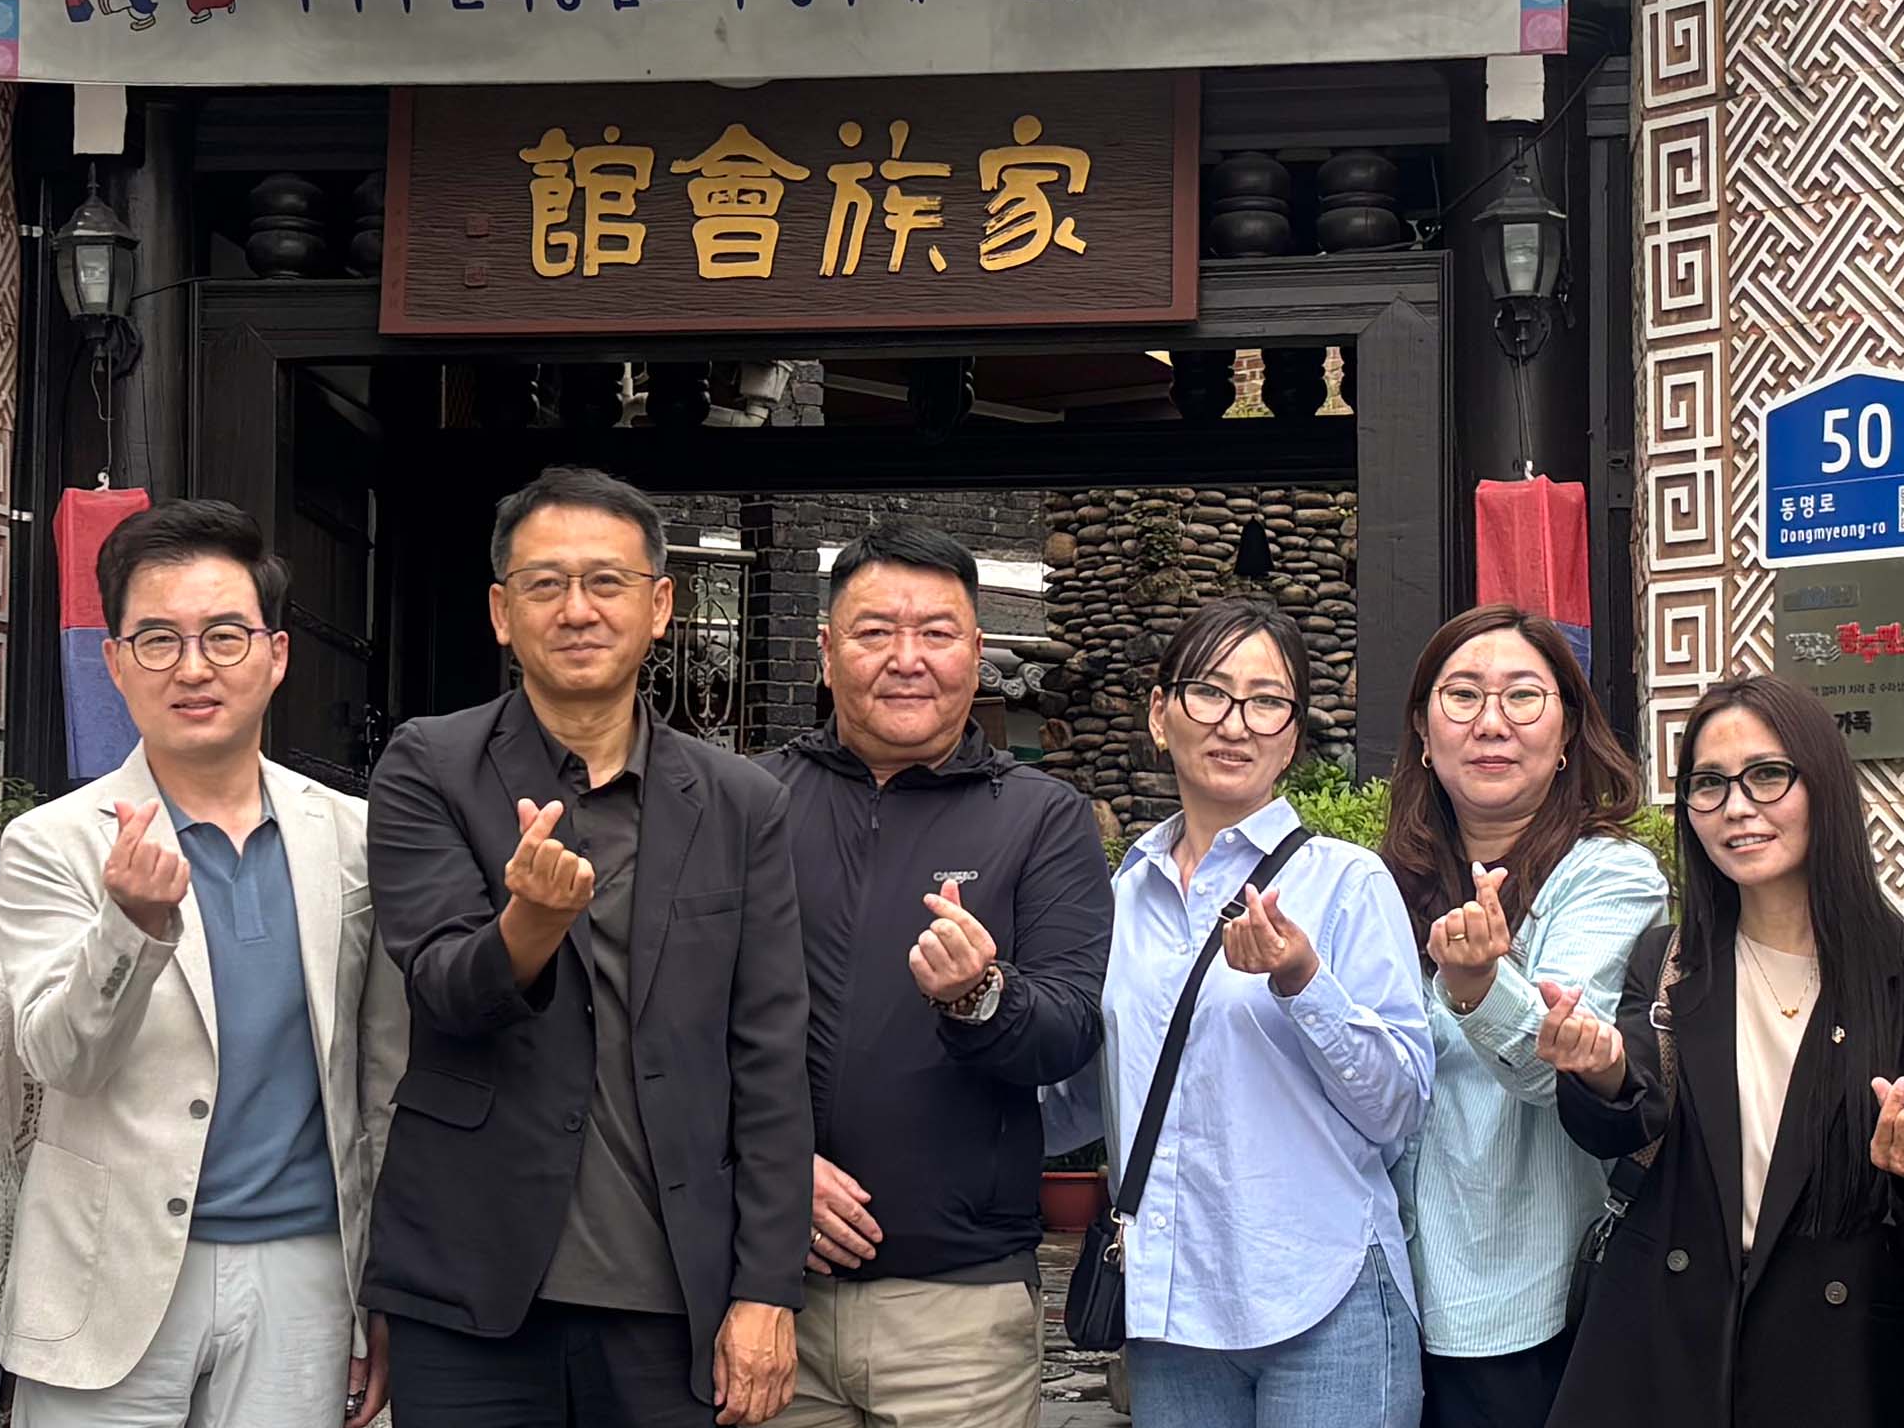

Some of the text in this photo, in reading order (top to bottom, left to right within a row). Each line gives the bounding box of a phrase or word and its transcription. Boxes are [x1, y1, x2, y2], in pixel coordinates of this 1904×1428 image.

[1821, 402, 1893, 474] 50
[1779, 493, 1836, 521] 동명로
[1780, 521, 1887, 544] Dongmyeong-ro
